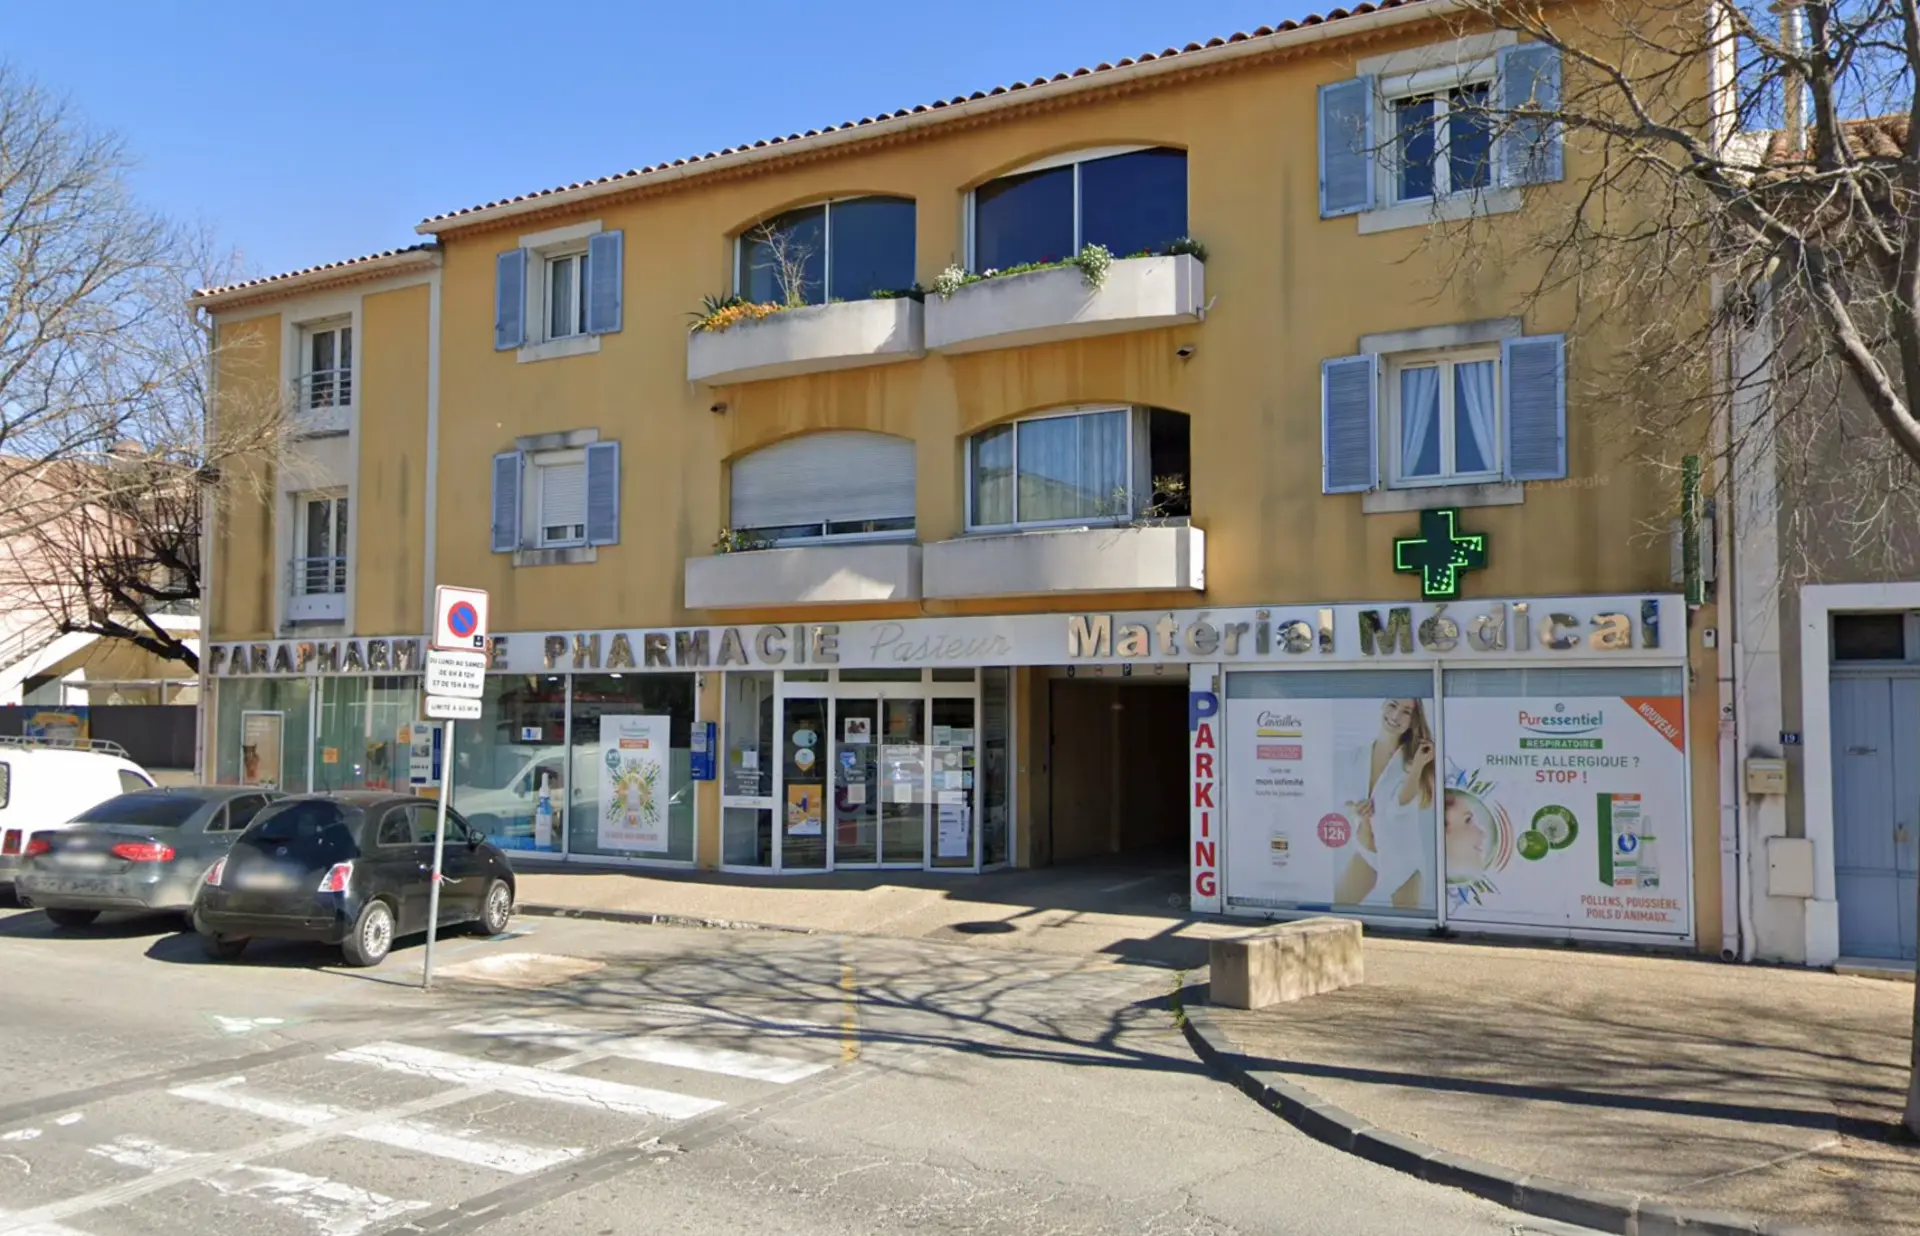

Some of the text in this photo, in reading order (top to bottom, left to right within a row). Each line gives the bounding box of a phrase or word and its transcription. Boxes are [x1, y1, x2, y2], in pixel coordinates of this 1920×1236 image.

[544, 624, 840, 669] PHARMACIE
[869, 622, 1012, 661] Pasteur
[1358, 599, 1660, 655] Médical
[1518, 710, 1603, 726] Puressentiel
[1638, 702, 1680, 739] NOUVEAU
[1526, 739, 1596, 749] RESPIRATOIRE
[1486, 754, 1640, 769] RHINITE ALLERGIQUE ?
[1535, 770, 1578, 784] STOP
[1188, 690, 1219, 898] PARKING
[1323, 827, 1346, 842] 12h
